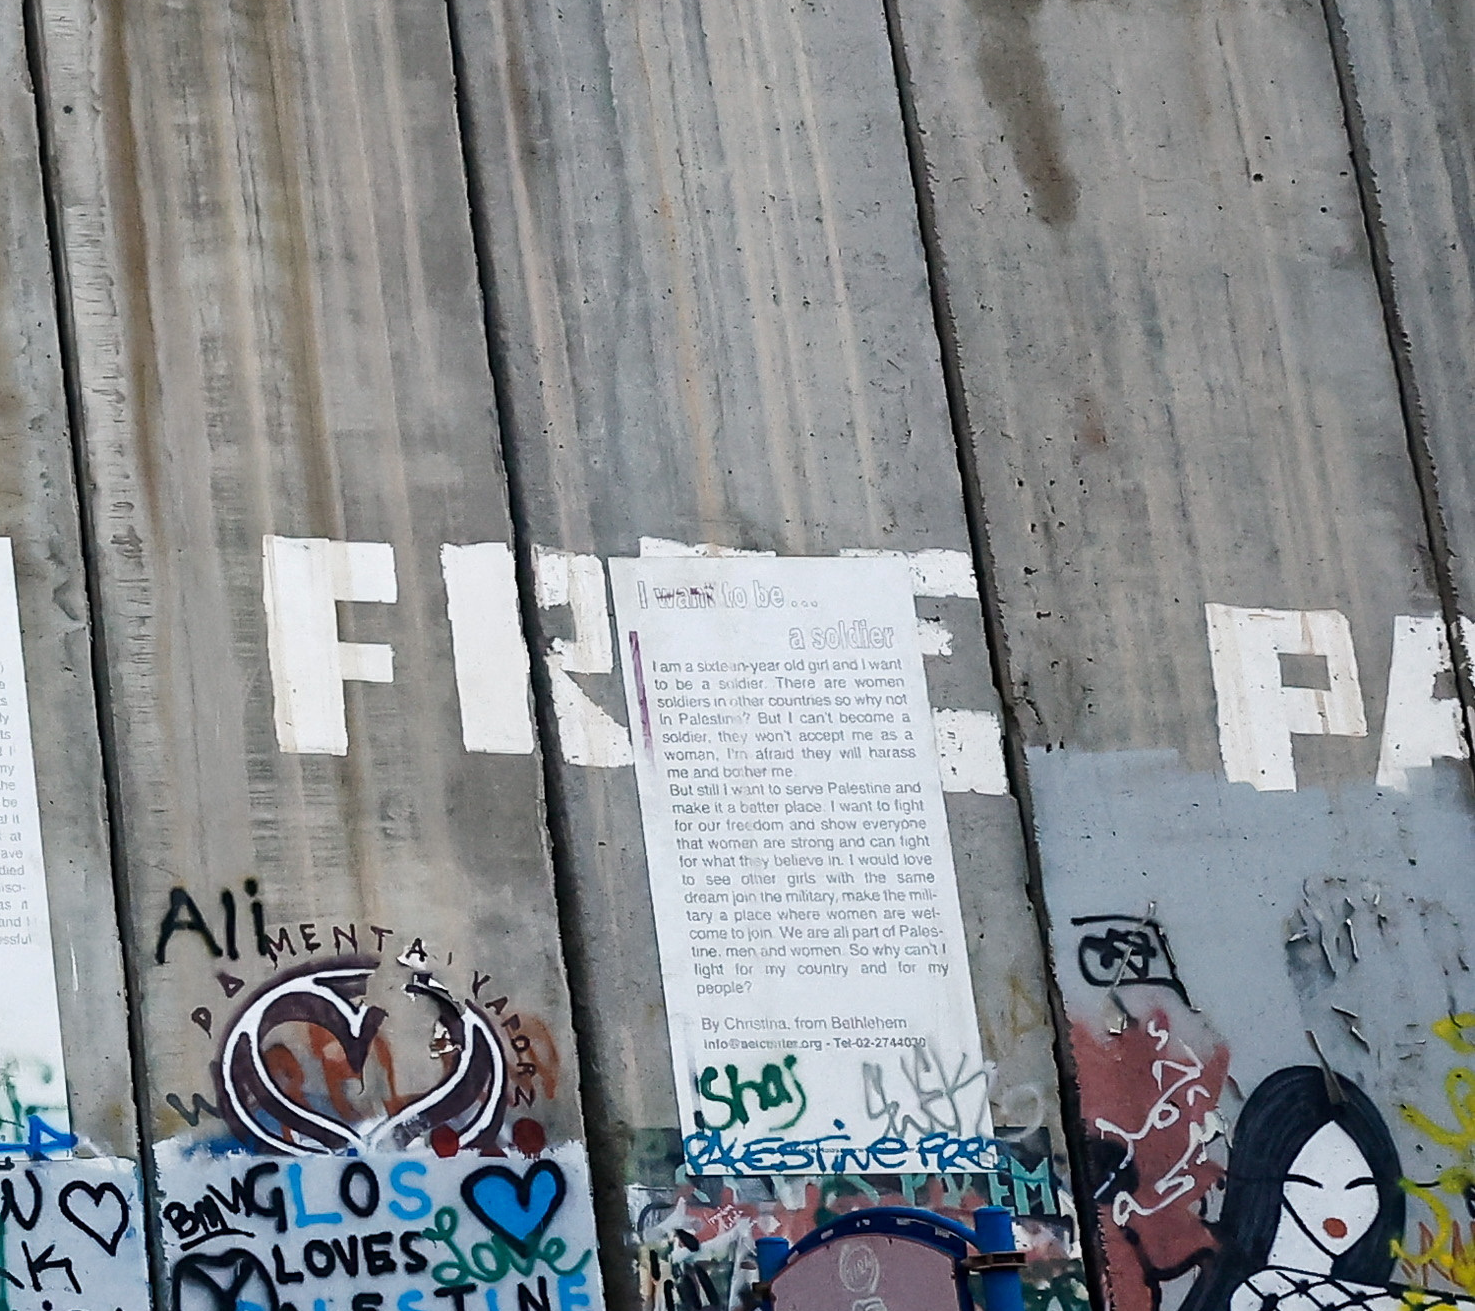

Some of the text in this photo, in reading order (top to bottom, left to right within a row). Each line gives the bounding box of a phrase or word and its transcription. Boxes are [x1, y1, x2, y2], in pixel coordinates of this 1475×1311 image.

[724, 582, 747, 609] to
[753, 579, 785, 609] be
[788, 619, 895, 650] a soldier
[675, 836, 704, 851] that
[706, 838, 759, 851] women
[762, 838, 786, 849] are
[790, 836, 835, 852] strong
[838, 835, 866, 849] and
[868, 837, 897, 849] can
[700, 1016, 720, 1034] By
[793, 1016, 828, 1031] from
[830, 1015, 908, 1031] Bethlehem
[244, 1160, 433, 1234] GLOS
[272, 1229, 430, 1286] LOVES
